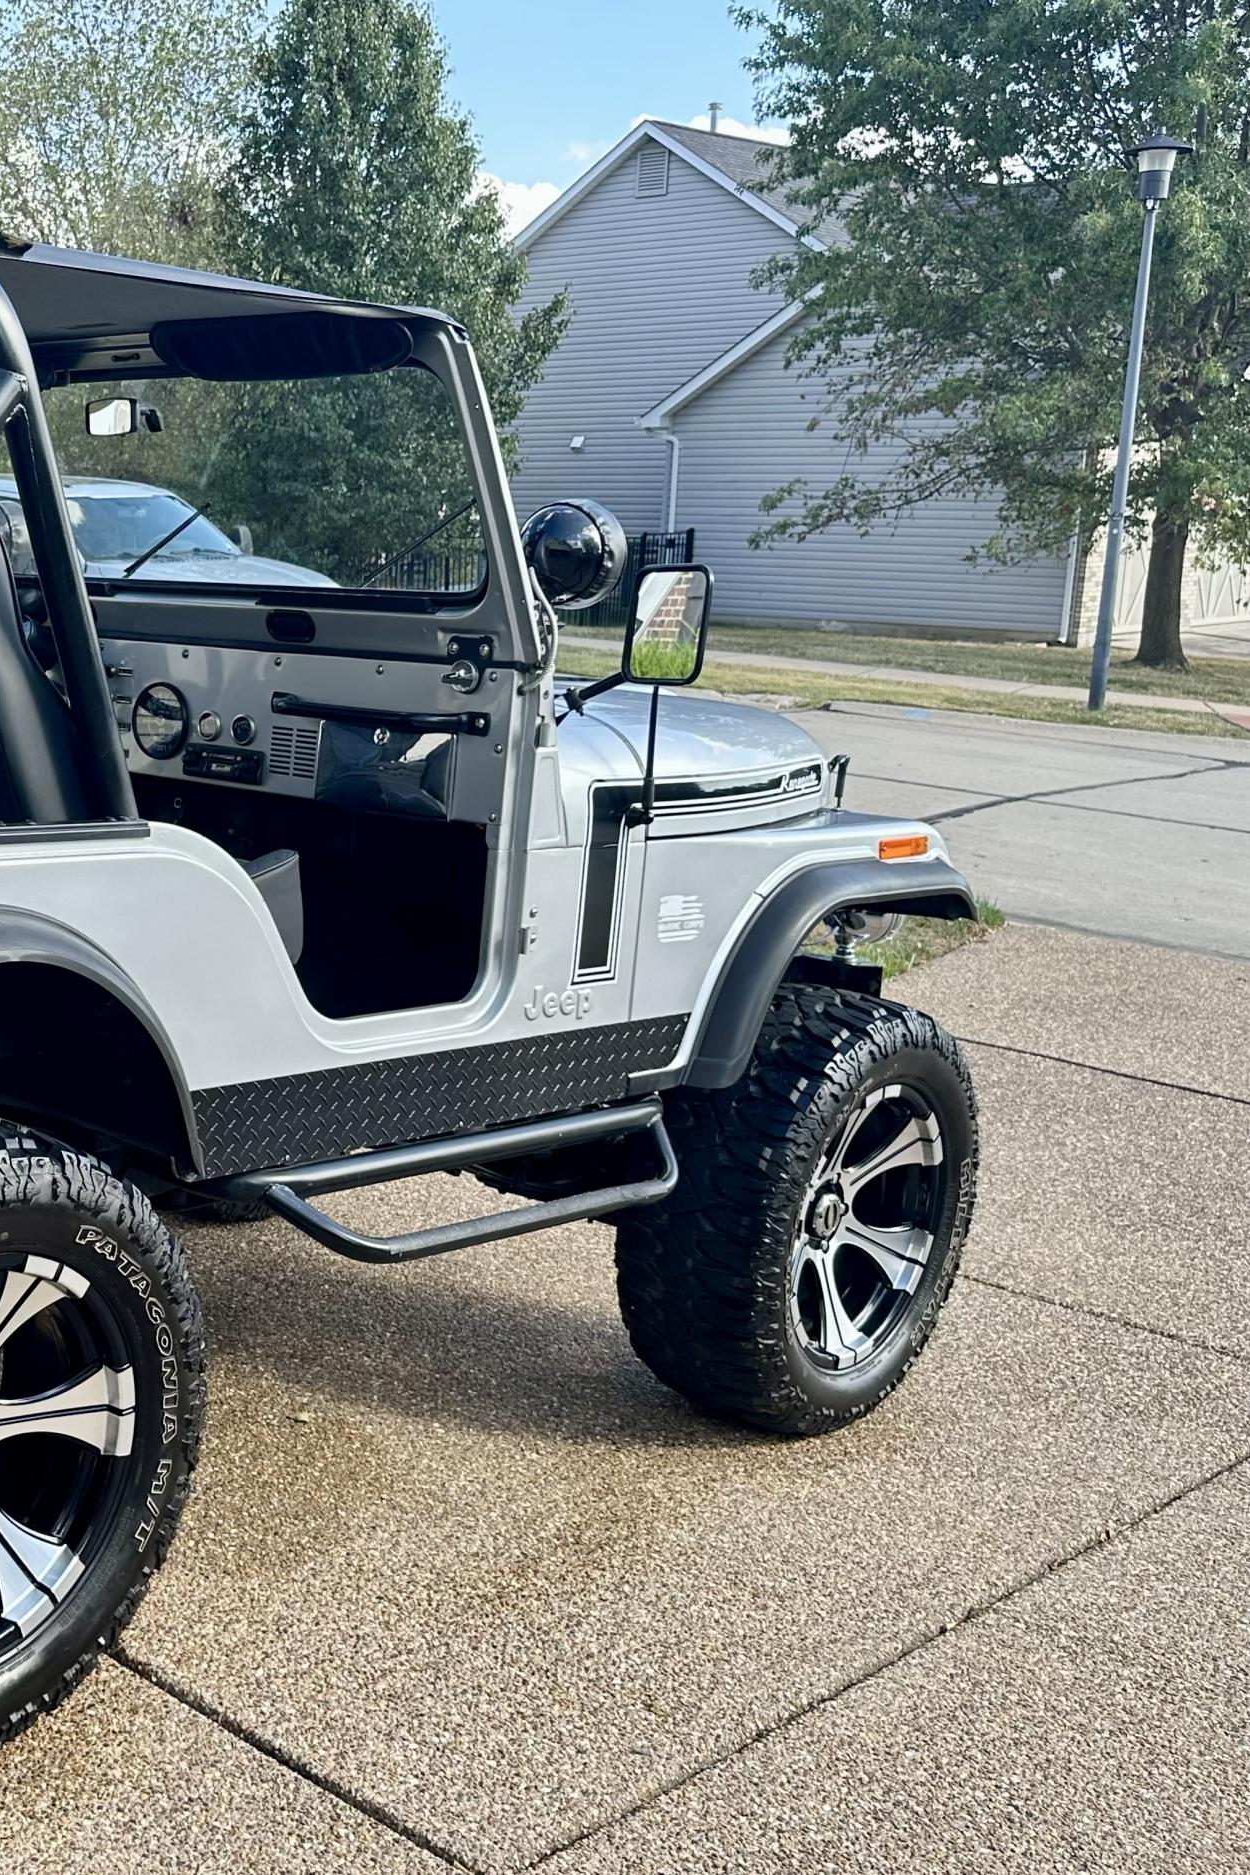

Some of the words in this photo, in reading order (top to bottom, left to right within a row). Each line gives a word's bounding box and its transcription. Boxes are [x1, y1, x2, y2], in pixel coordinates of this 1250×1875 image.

[523, 984, 593, 1021] Jeep
[910, 1157, 972, 1347] MILESTAR
[75, 1224, 179, 1444] PATAGONIA
[134, 1458, 172, 1553] M/T
